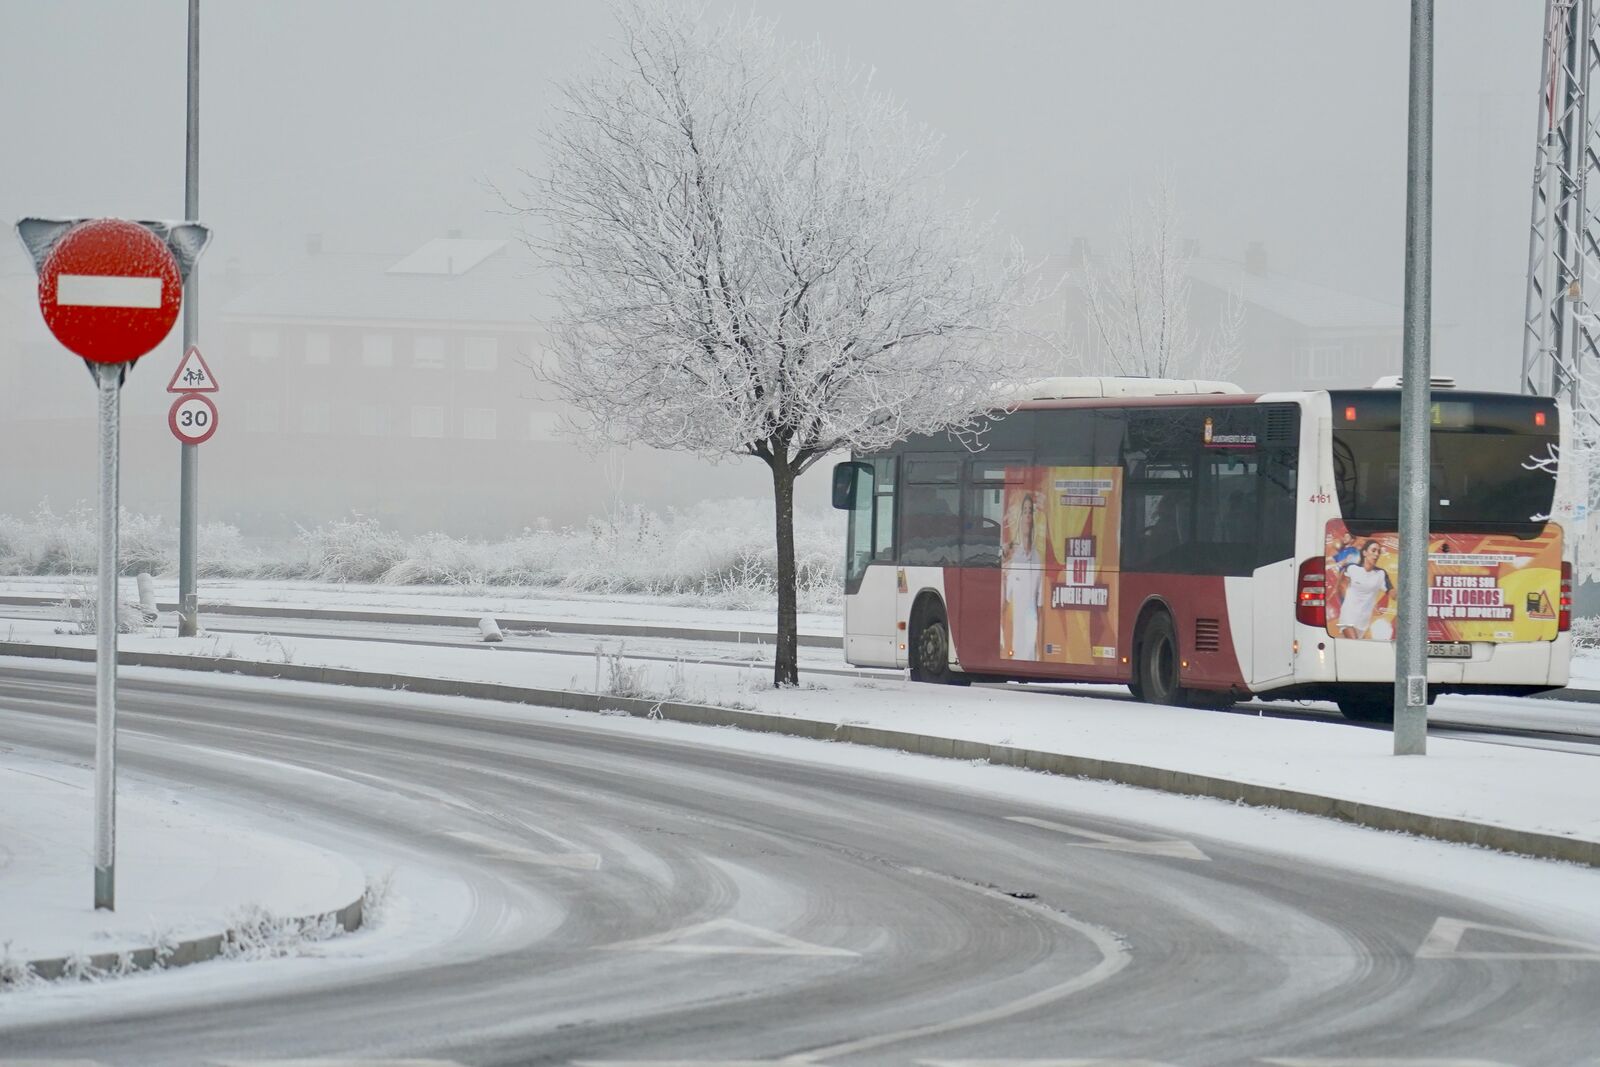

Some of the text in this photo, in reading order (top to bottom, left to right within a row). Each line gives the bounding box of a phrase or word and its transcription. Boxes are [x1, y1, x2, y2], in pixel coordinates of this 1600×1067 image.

[181, 410, 208, 427] 30
[1240, 435, 1247, 443] DE
[1309, 494, 1331, 504] 4161
[1442, 576, 1452, 587] SI
[1453, 576, 1478, 588] ESTOS
[1478, 577, 1496, 588] SON
[1431, 589, 1500, 606] MIS LOGROS
[1427, 606, 1438, 617] OR
[1427, 645, 1445, 655] 785
